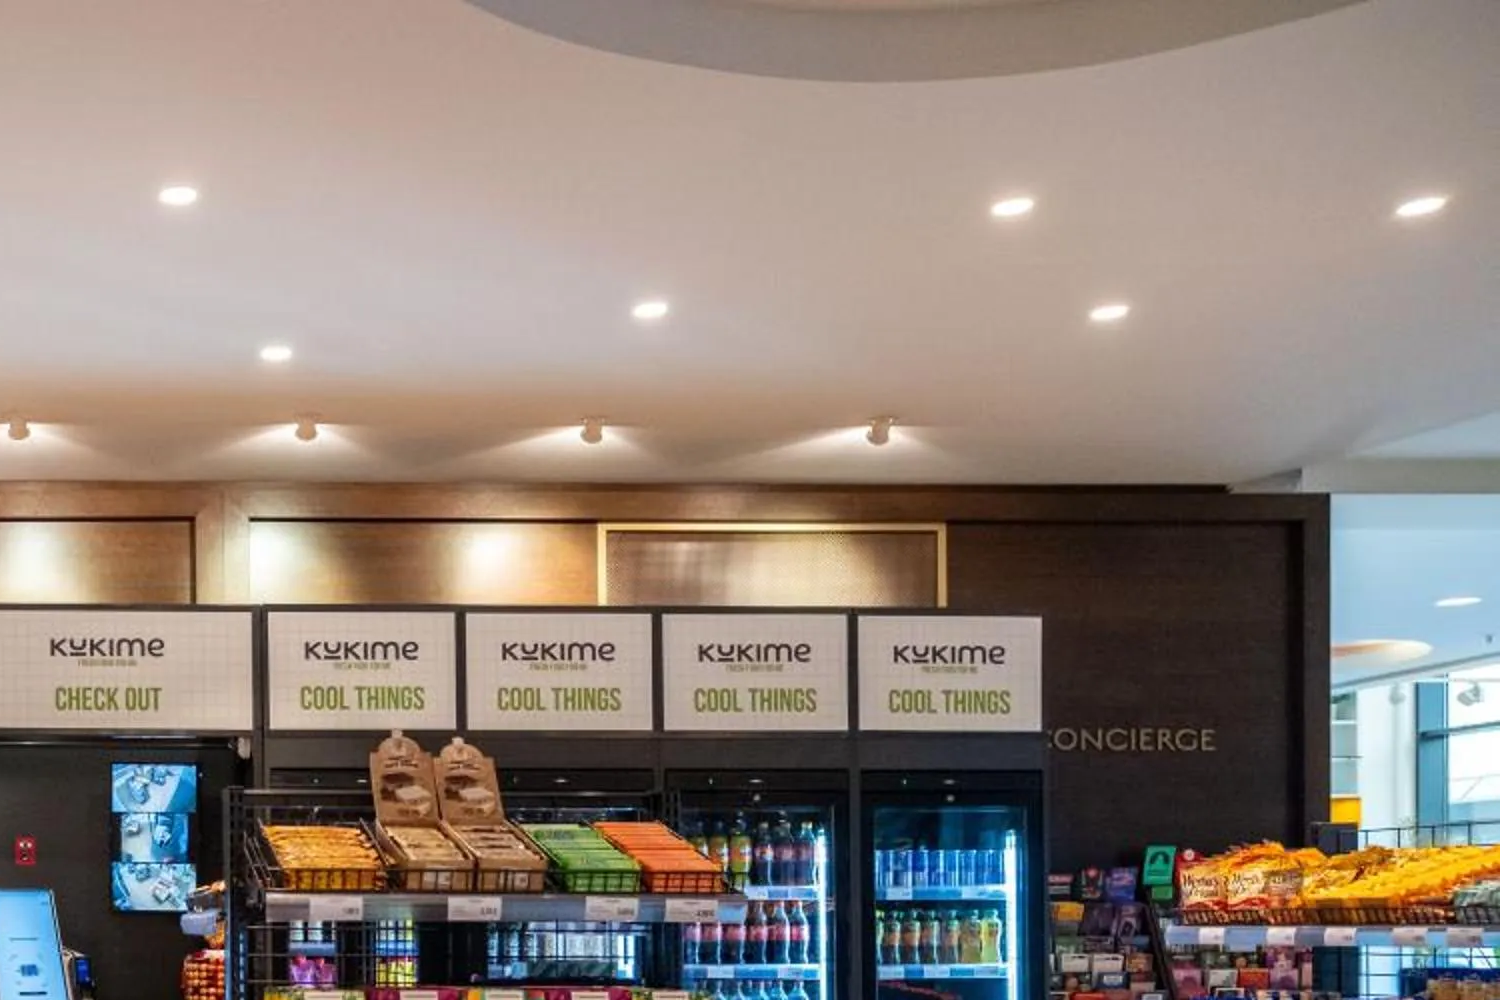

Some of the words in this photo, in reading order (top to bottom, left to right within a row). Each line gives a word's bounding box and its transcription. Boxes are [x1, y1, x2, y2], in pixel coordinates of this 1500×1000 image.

[55, 687, 119, 711] CHECK
[125, 687, 162, 711] OUT
[300, 686, 350, 710] COOL
[355, 686, 425, 710] THINGS
[497, 687, 546, 711] COOL
[551, 687, 622, 711] THINGS
[694, 687, 743, 713] COOL
[748, 687, 818, 713] THINGS
[889, 689, 938, 713] COOL
[942, 689, 1011, 714] THINGS
[1048, 727, 1216, 751] ONCIERGE
